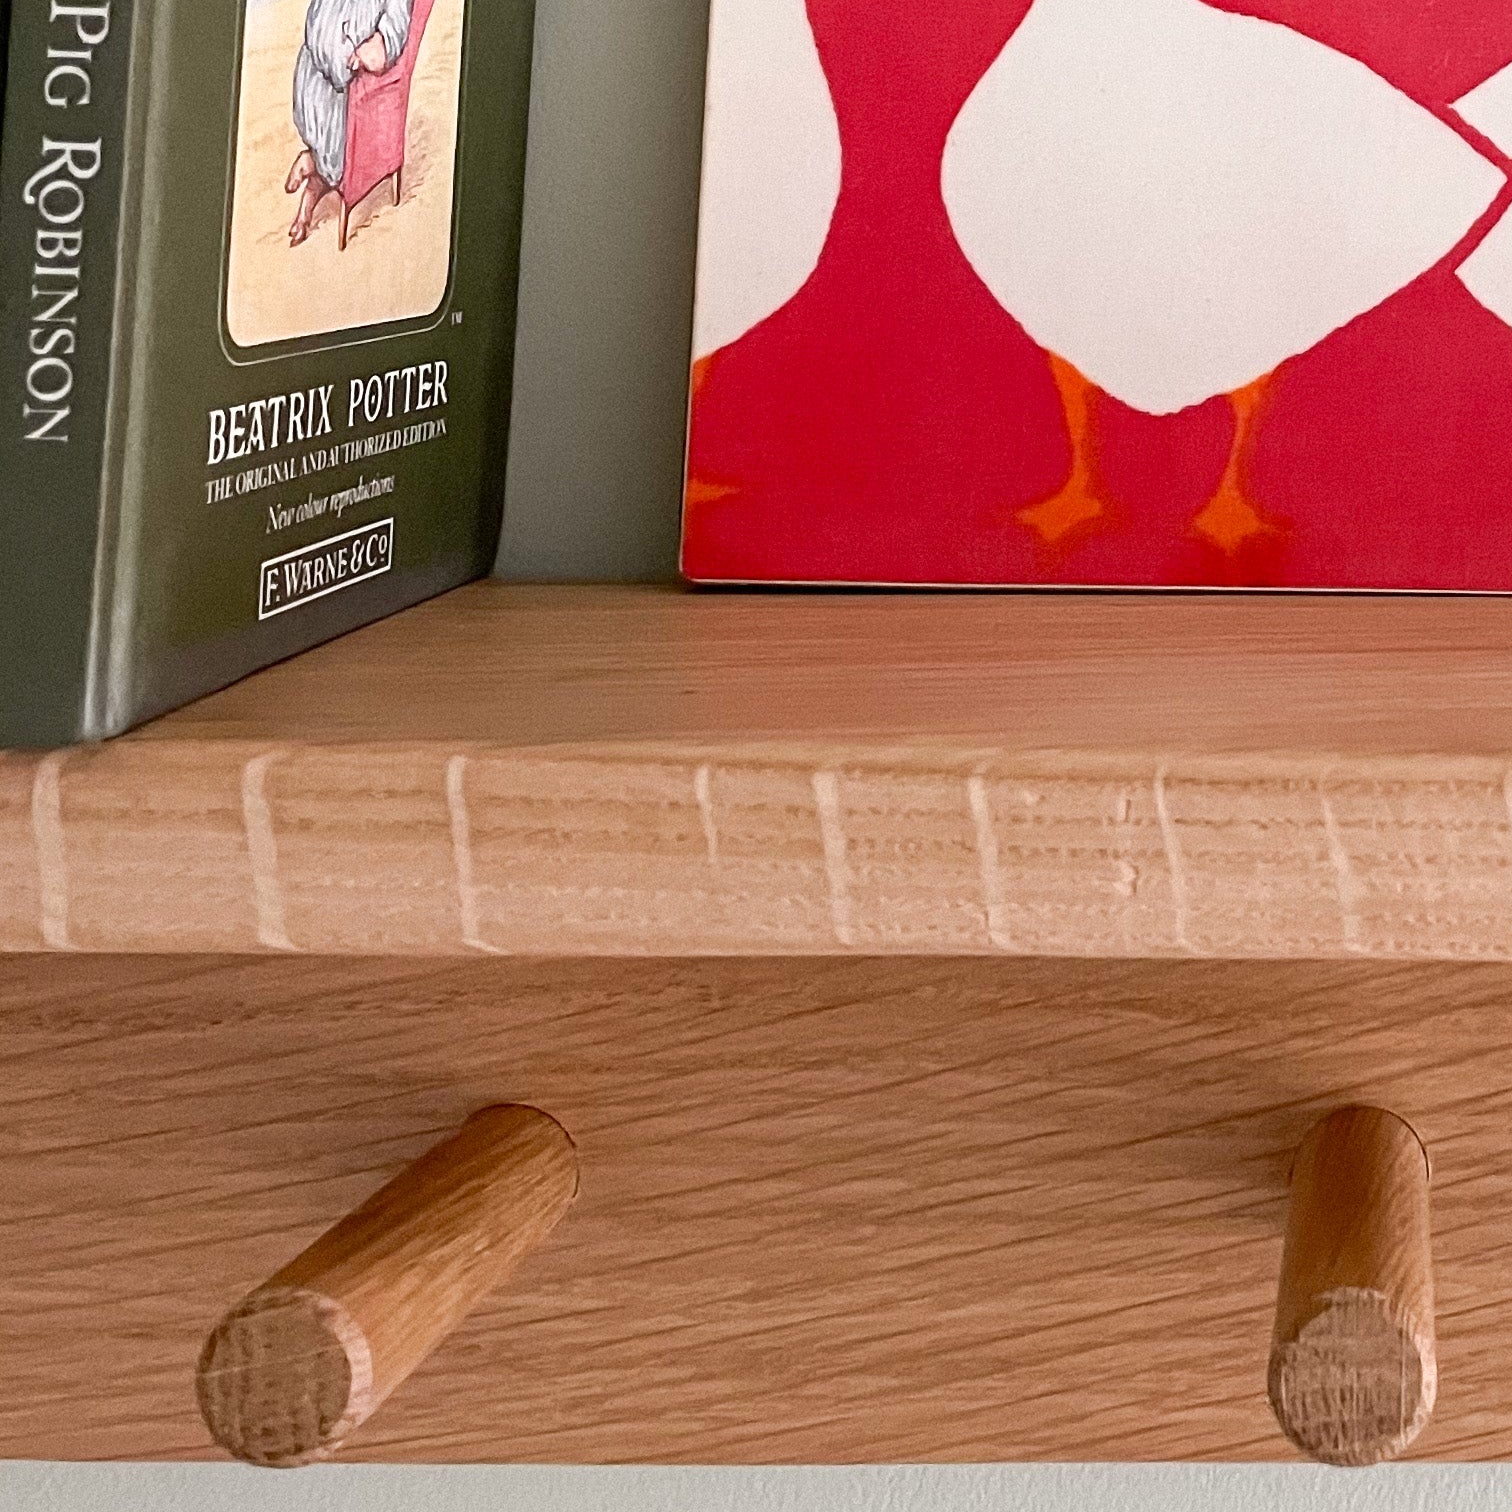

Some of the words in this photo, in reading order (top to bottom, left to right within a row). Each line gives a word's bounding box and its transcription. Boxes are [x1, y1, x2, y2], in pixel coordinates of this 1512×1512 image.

[43, 0, 112, 109] PIG
[23, 136, 102, 443] ROBINSON
[206, 475, 234, 504] THE
[236, 458, 298, 495] ORIGINAL
[402, 418, 447, 447] EDITION
[207, 384, 334, 465] BEATRIX
[348, 360, 448, 427] POTTER
